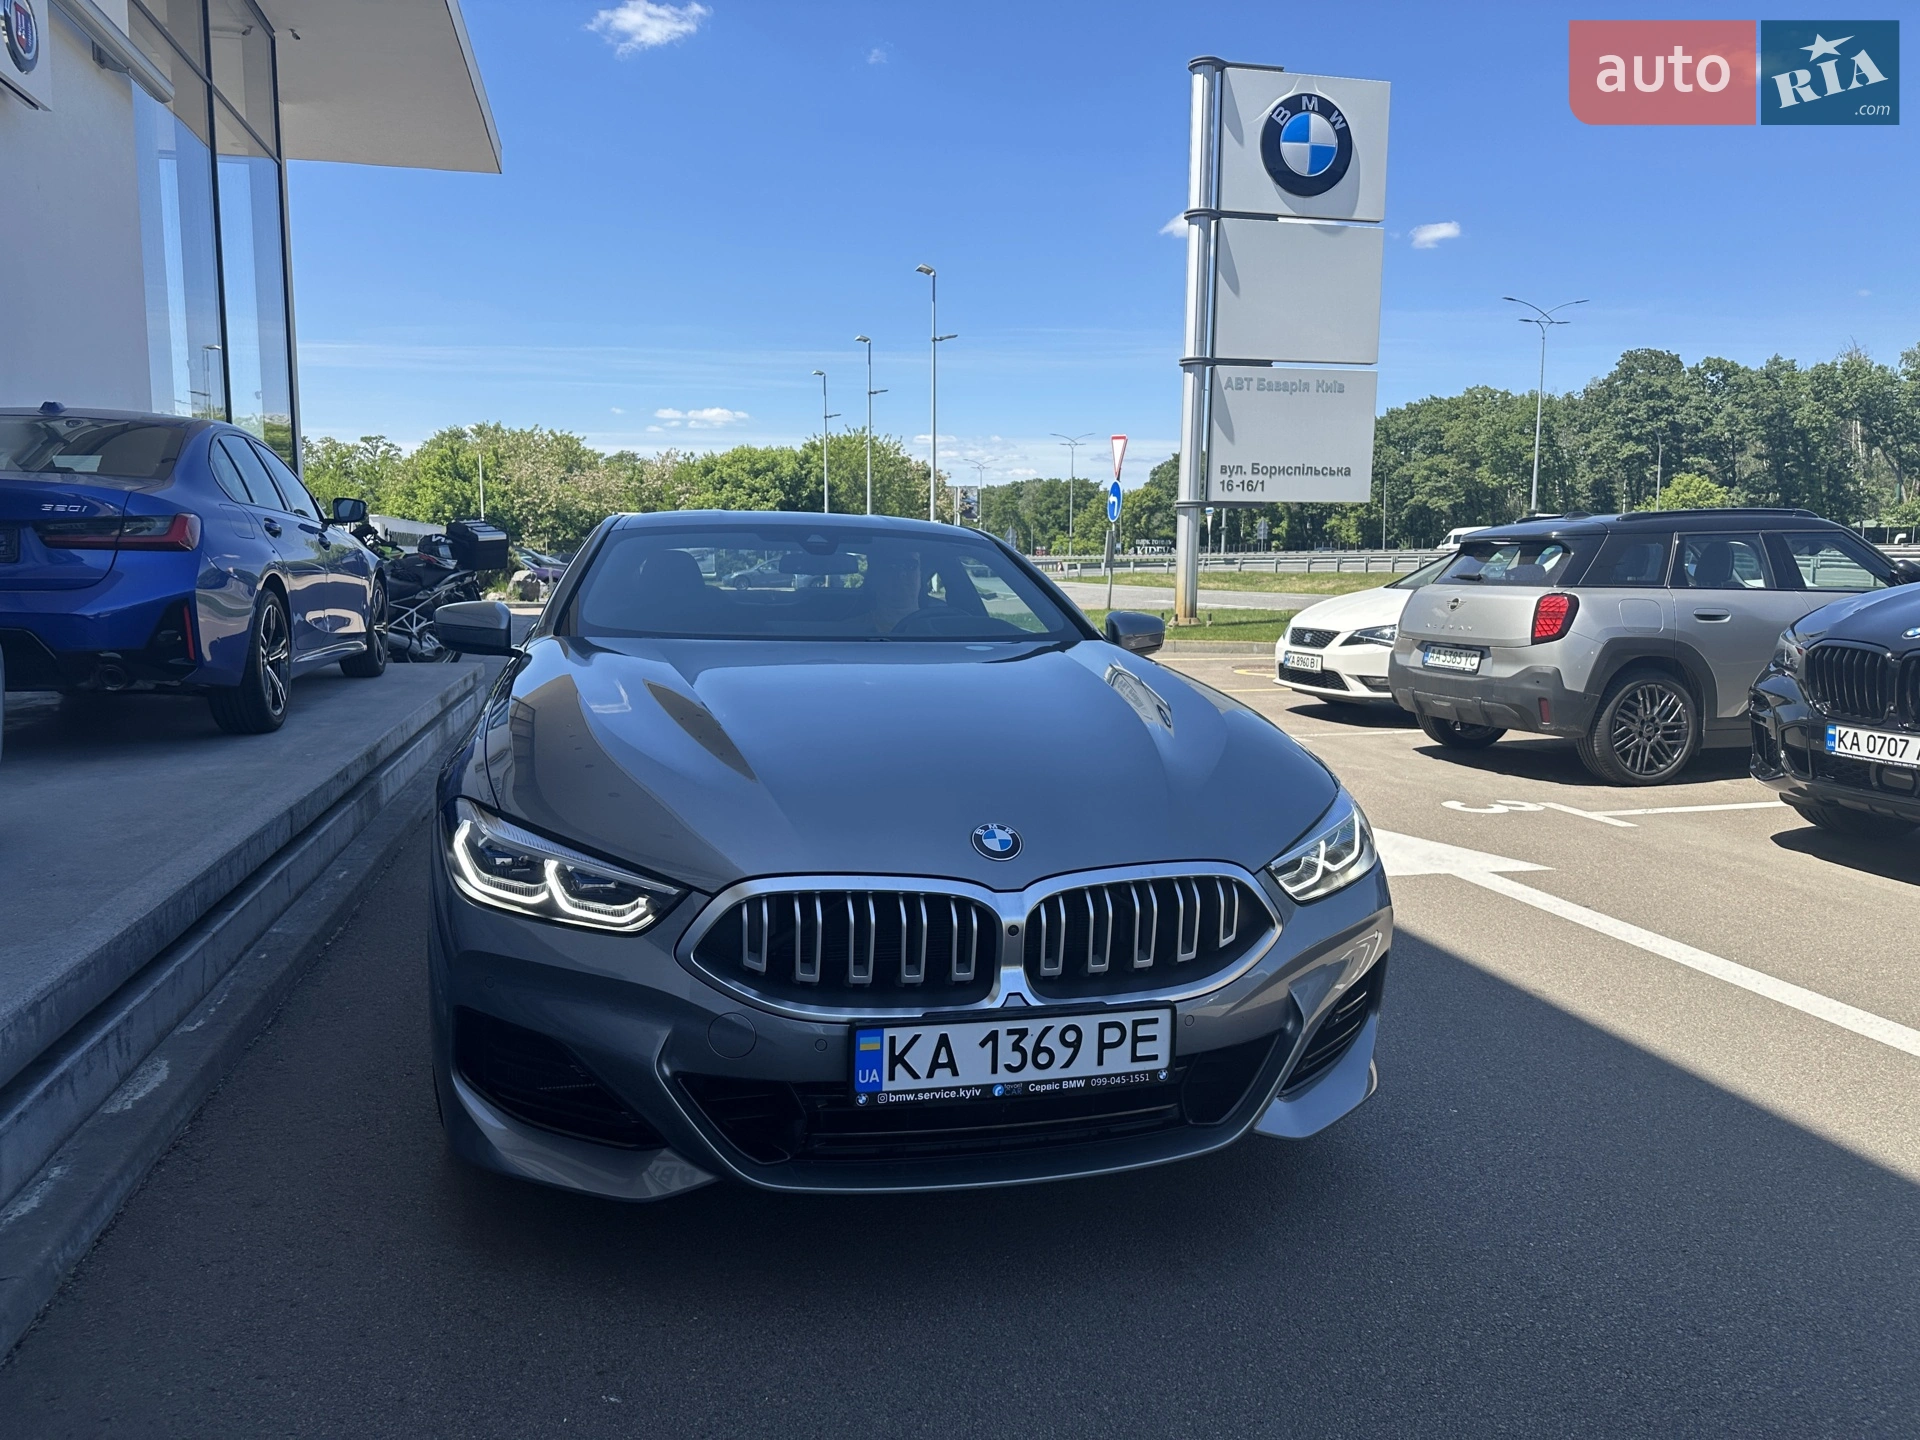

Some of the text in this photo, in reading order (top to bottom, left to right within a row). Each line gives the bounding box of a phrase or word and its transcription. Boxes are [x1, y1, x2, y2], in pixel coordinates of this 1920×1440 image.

[1271, 95, 1347, 131] BMW
[1224, 377, 1345, 395] АВТ Баварія Київ
[1220, 463, 1351, 478] вул. Бориспільська
[1219, 479, 1265, 492] 16-16/1
[1429, 649, 1442, 662] AA
[1837, 729, 1861, 751] KA
[1866, 734, 1910, 758] 0707
[888, 1017, 1159, 1081] KA 1369 PE
[858, 1069, 880, 1083] UA
[1028, 1073, 1150, 1093] Сервіс BMW 099-045-1551
[889, 1087, 981, 1102] bmw.service.kyiv
